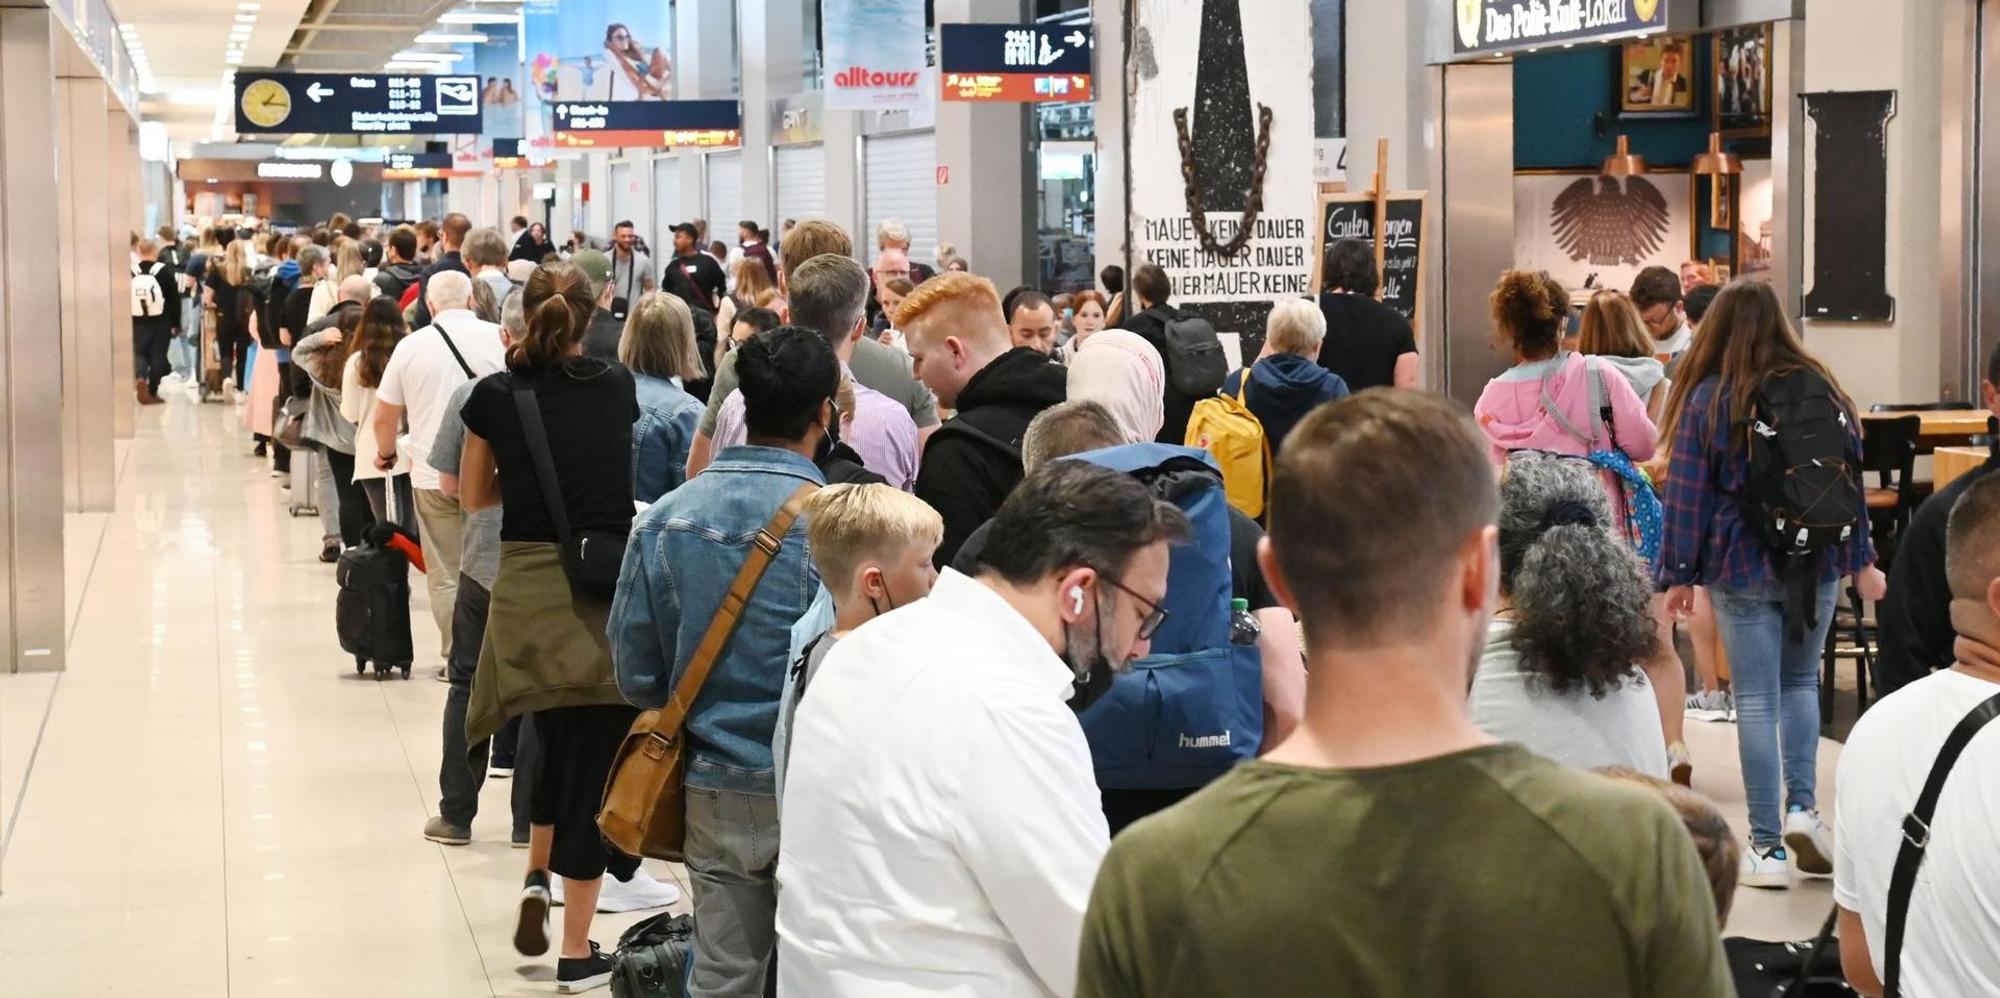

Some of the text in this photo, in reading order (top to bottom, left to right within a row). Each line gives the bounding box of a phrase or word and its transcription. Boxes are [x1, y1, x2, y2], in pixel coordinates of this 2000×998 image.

[1485, 8, 1512, 42] Das
[834, 67, 919, 89] alltours
[1146, 217, 1305, 241] MAUE KEIN DAUER
[1328, 207, 1413, 249] Guten orgen
[1256, 245, 1304, 267] DAUER
[1170, 272, 1307, 296] UER MAUER KEINE
[1178, 729, 1231, 748] hummel
